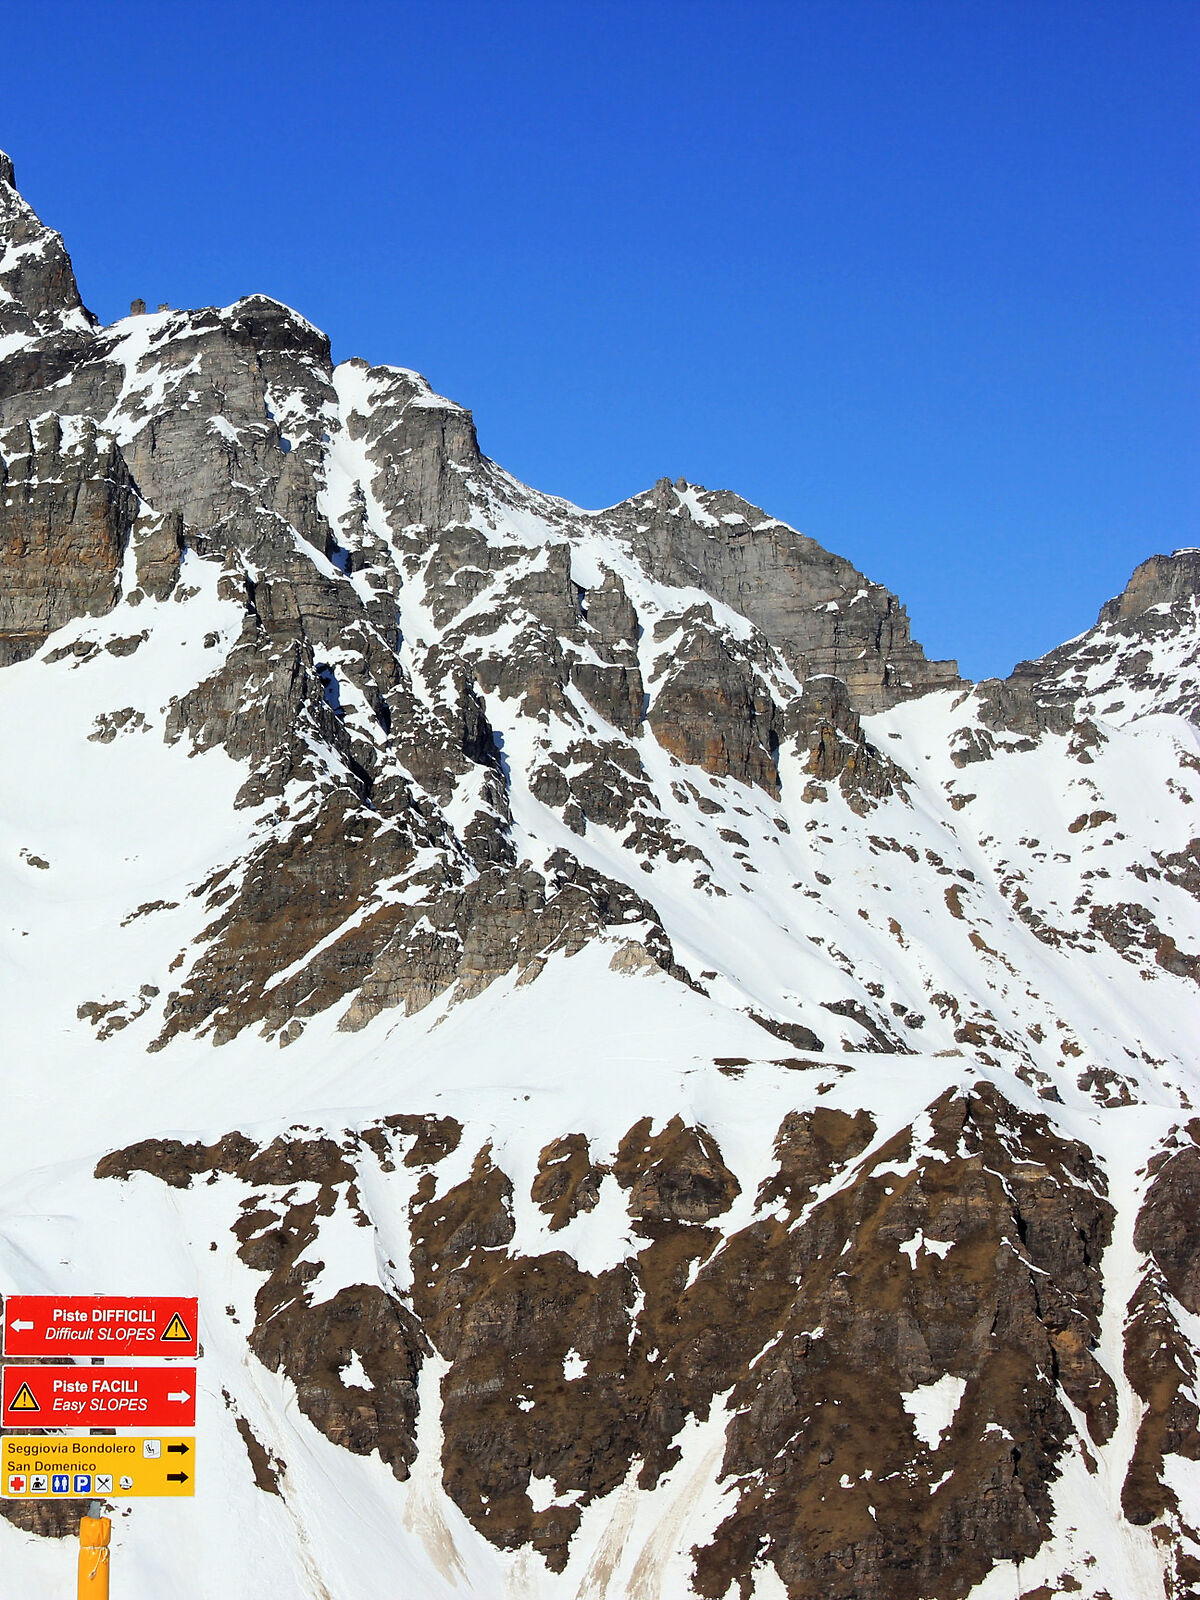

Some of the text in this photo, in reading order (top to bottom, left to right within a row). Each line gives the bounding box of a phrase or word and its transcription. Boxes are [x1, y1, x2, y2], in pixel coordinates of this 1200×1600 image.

[53, 1309, 156, 1322] Piste DIFFICILI
[45, 1327, 156, 1341] Difficult SLOPES
[53, 1380, 138, 1393] Piste FACILI
[53, 1398, 148, 1414] Easy SLOPES
[7, 1443, 136, 1456] Seggiovia Bondolero
[7, 1461, 97, 1472] San Domenico
[77, 1477, 89, 1491] P
